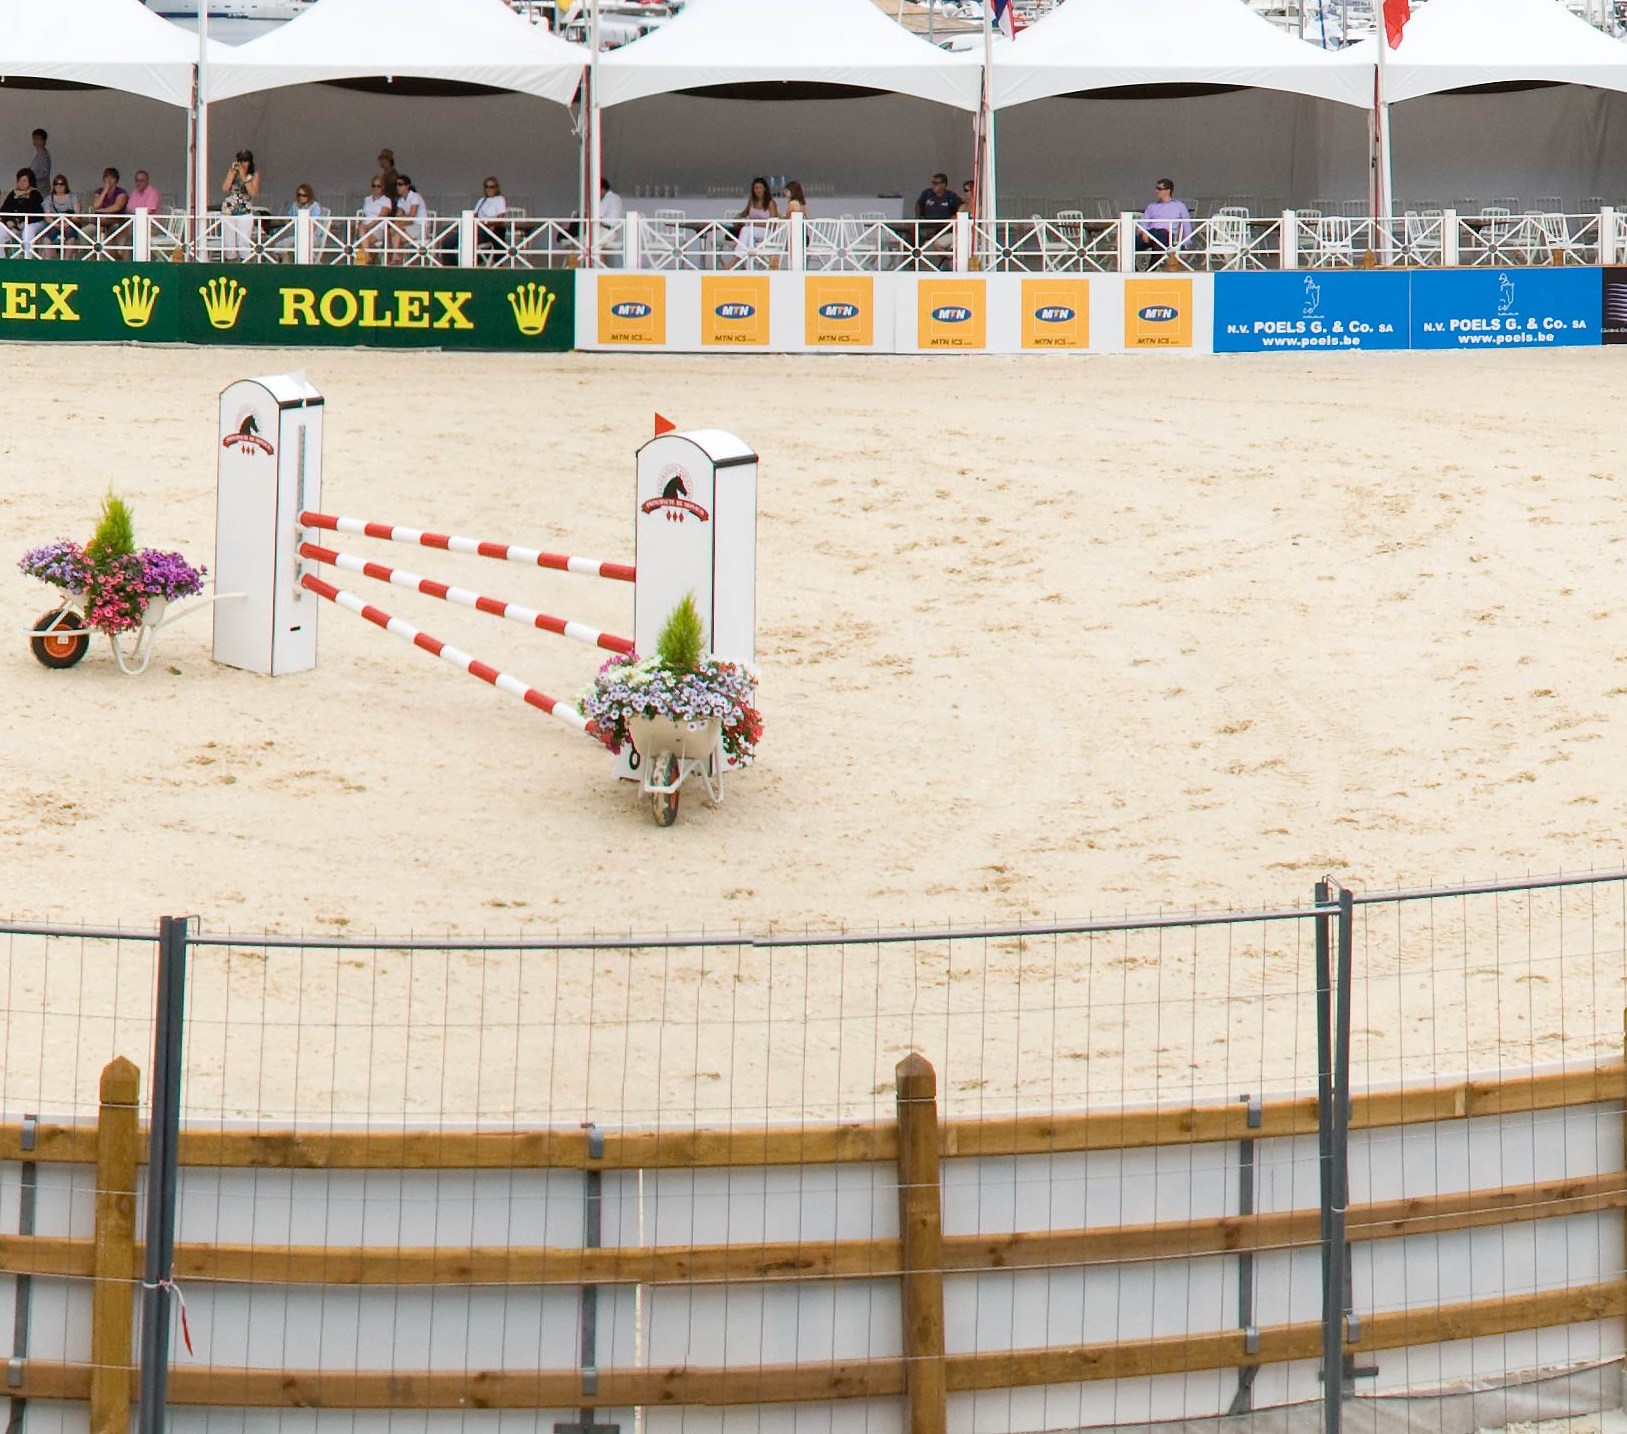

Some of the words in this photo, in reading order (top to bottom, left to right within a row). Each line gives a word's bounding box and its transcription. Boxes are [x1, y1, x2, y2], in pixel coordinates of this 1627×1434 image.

[278, 287, 474, 330] ROLEX
[618, 305, 645, 316] MTN
[721, 305, 749, 316] MTN
[825, 305, 852, 316] MTN
[938, 309, 966, 319] MTN
[1042, 309, 1069, 319] MTN
[1145, 309, 1172, 319] MTN
[1227, 324, 1249, 334] N.V.
[1254, 321, 1306, 333] POELS
[1310, 321, 1327, 333] G.
[1332, 320, 1344, 333] &
[1348, 320, 1374, 333] Co.
[1378, 323, 1394, 333] SA
[1423, 322, 1446, 332] N.V.
[1449, 319, 1501, 331] POELS
[1505, 318, 1522, 330] G.
[1526, 318, 1539, 330] &
[1545, 317, 1568, 329] Co.
[1572, 320, 1587, 329] SA
[1262, 335, 1361, 348] www.poels.be
[1457, 331, 1555, 344] www.poels.be
